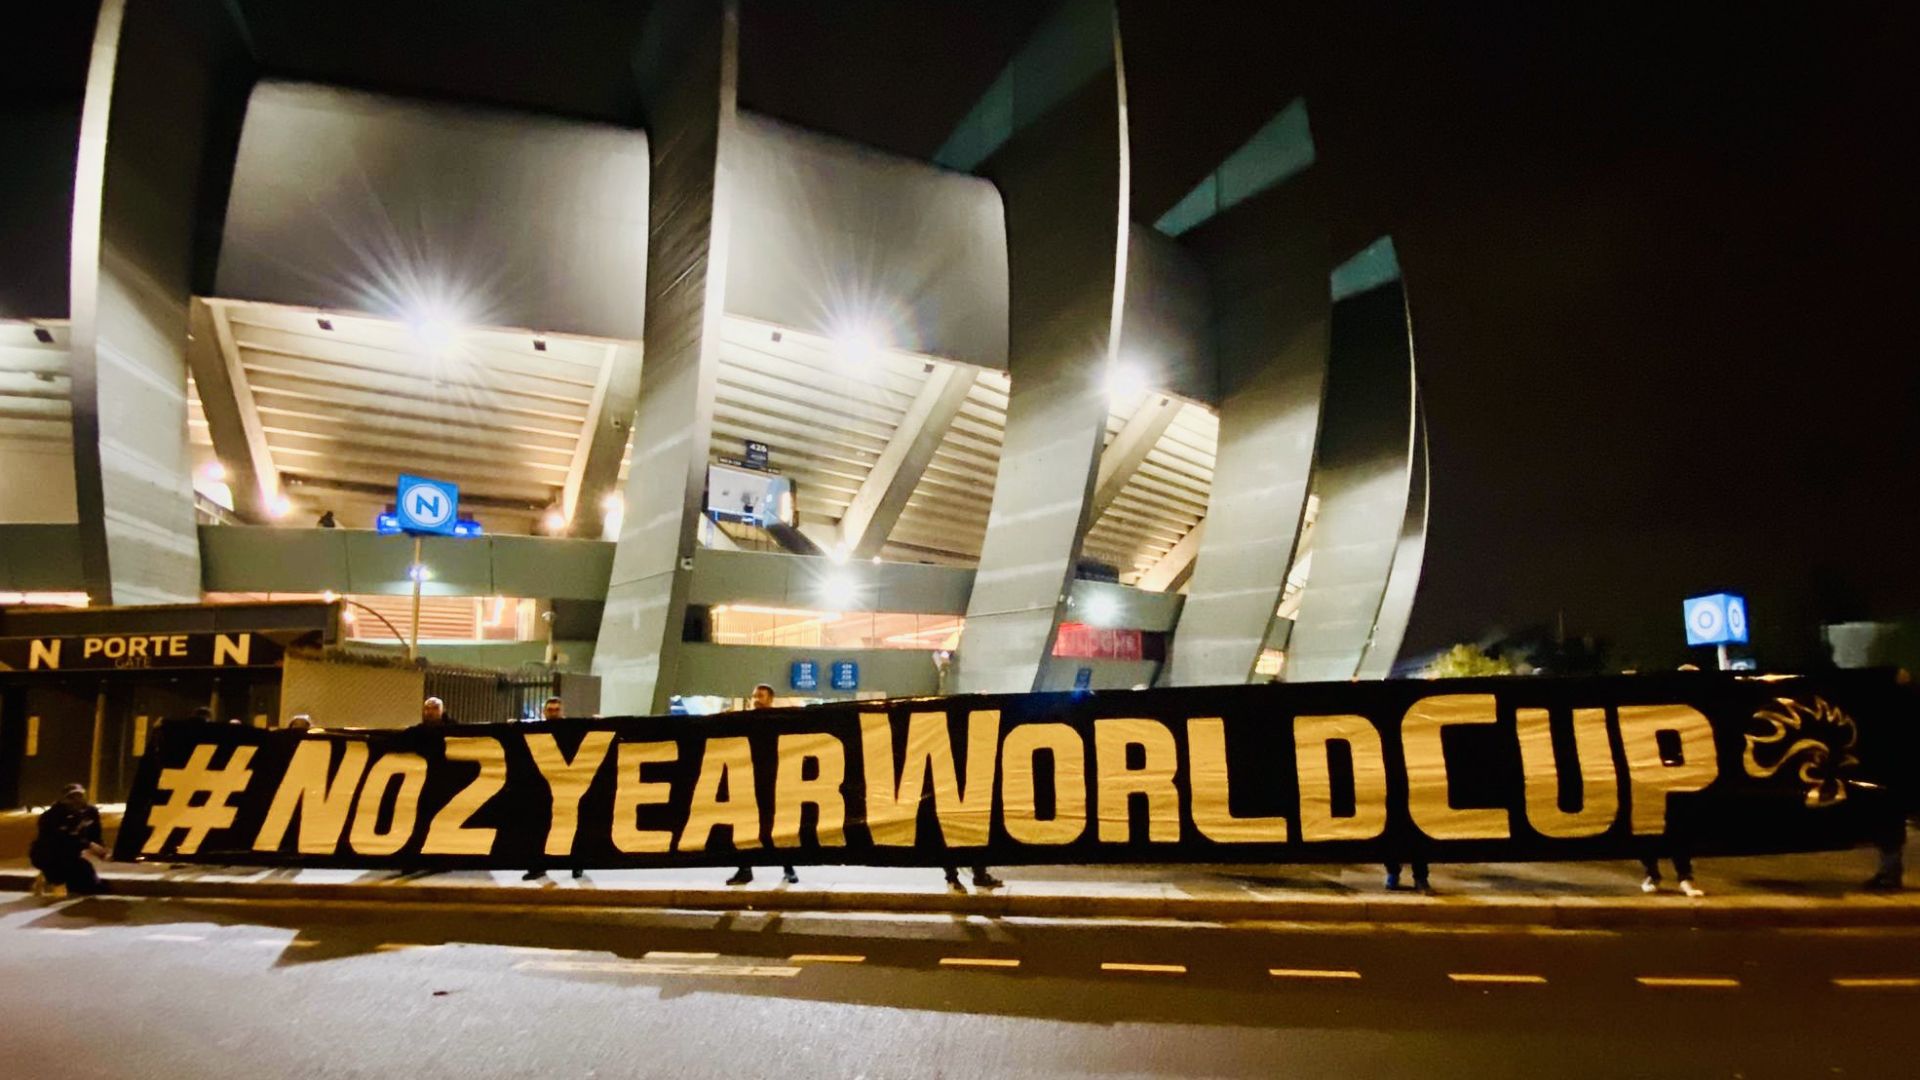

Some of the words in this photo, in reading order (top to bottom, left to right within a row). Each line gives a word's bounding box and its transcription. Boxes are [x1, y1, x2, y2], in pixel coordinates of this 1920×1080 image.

[416, 495, 439, 517] N
[29, 639, 61, 669] N
[83, 635, 189, 659] PORTE
[213, 633, 251, 666] N
